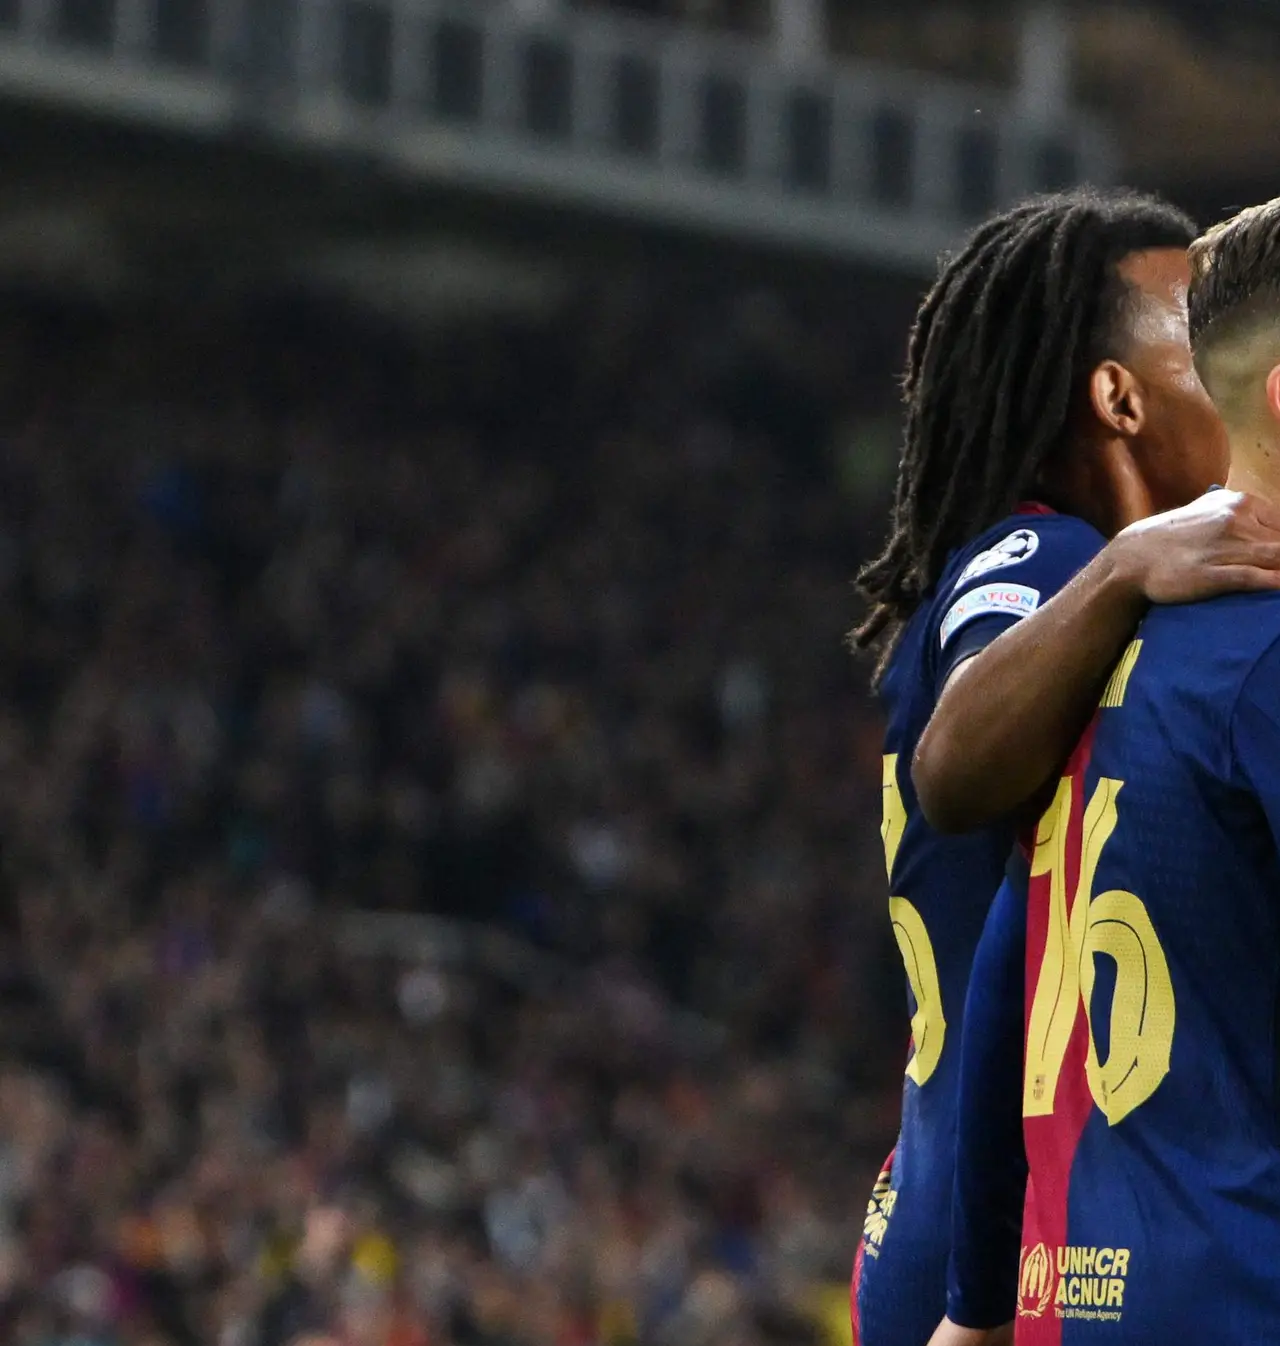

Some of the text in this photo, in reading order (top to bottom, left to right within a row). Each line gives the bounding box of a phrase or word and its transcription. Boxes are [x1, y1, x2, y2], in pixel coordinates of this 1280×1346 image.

[1022, 776, 1175, 1127] 16
[1056, 1246, 1130, 1276] UNHCR
[1054, 1277, 1124, 1307] ACNUR
